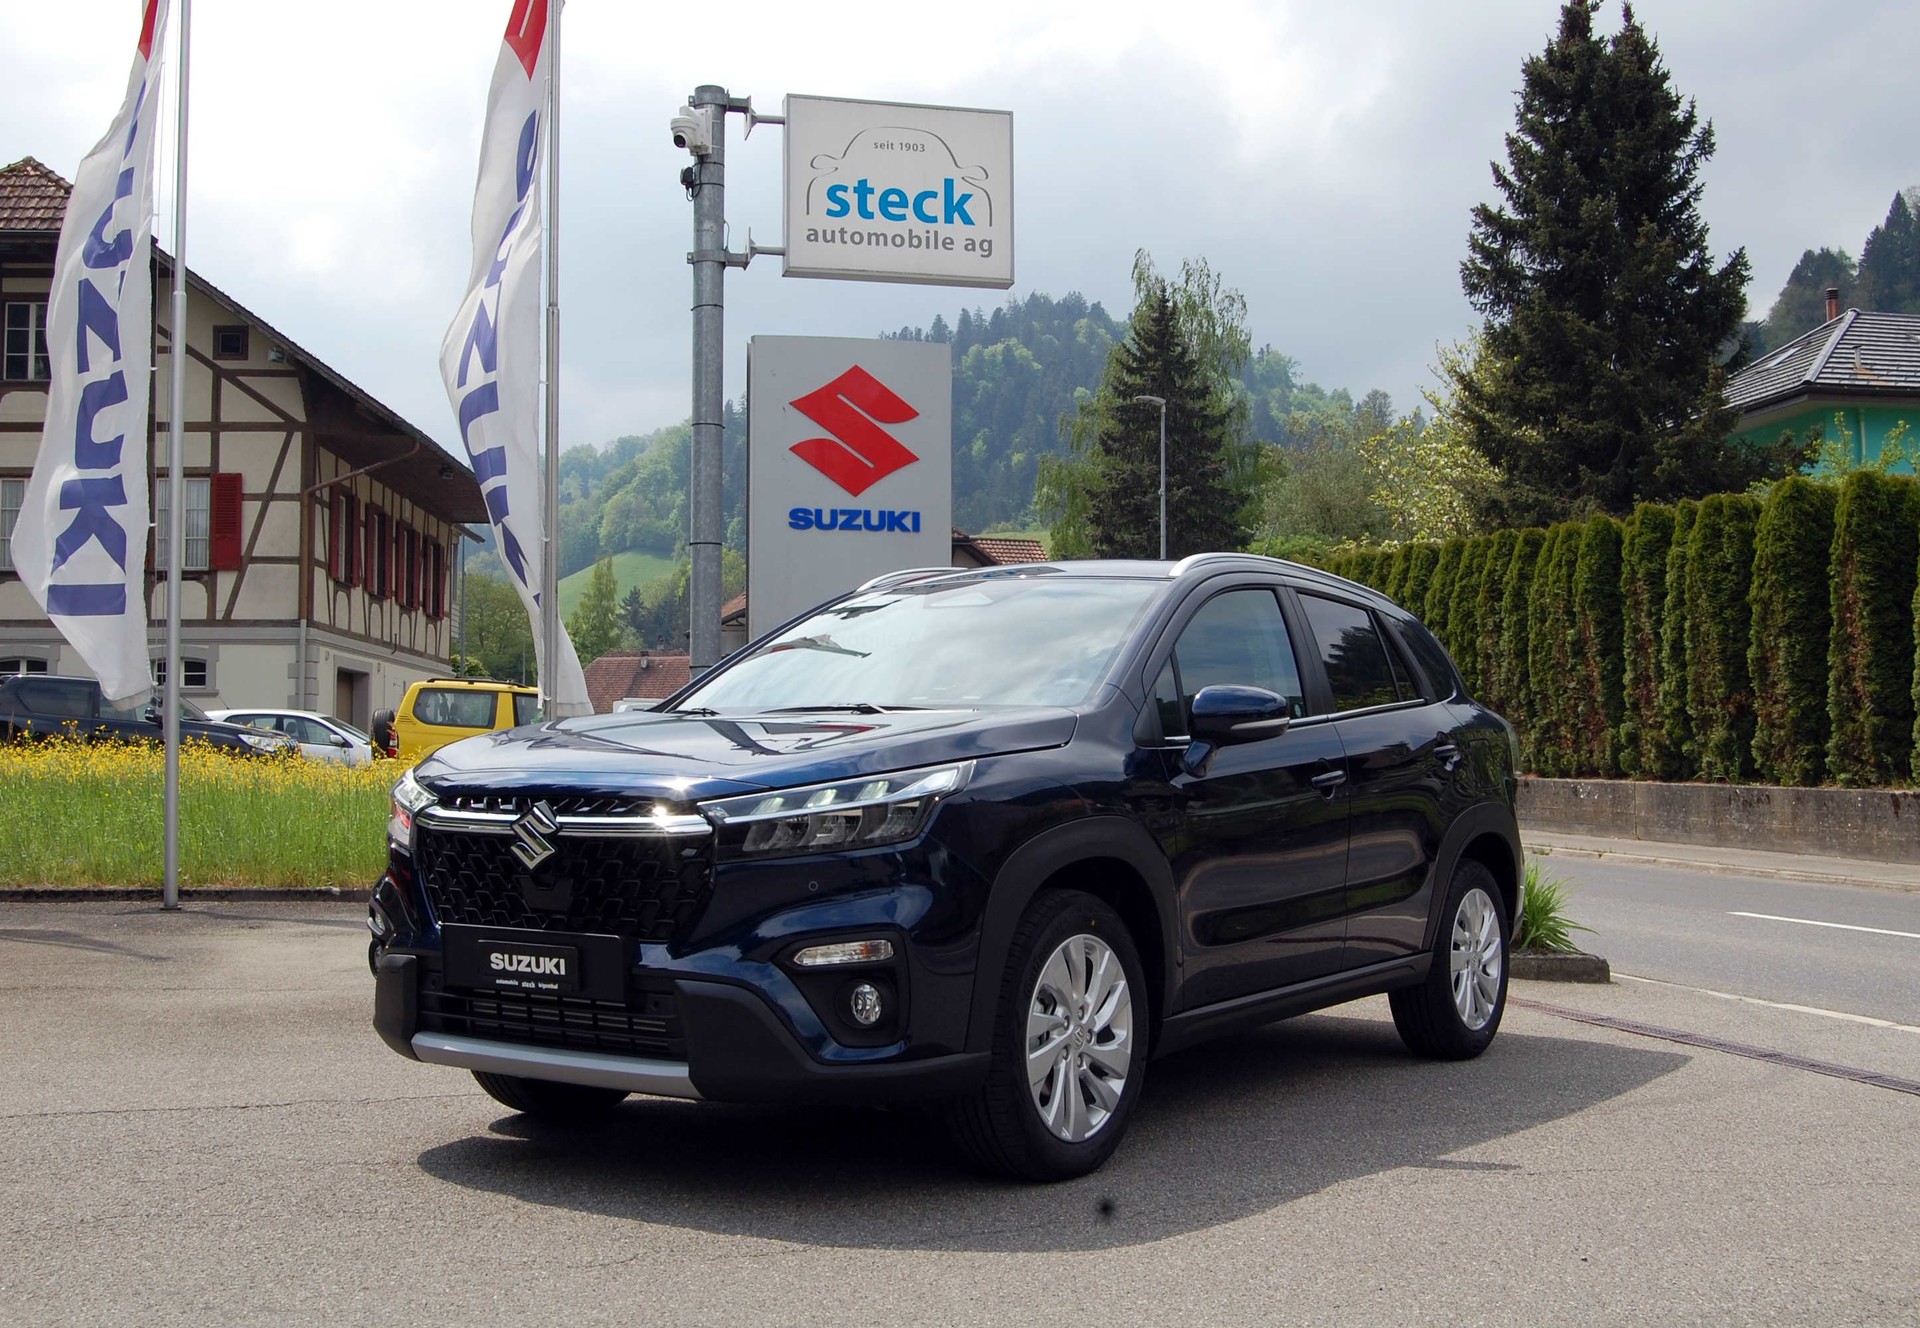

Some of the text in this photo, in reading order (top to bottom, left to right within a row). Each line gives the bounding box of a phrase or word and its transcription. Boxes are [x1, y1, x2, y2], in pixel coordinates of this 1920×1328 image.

[873, 140, 926, 153] seit 1903
[825, 178, 976, 226] steck
[806, 227, 993, 258] automobile ag
[788, 507, 920, 533] SUZUKI
[490, 953, 566, 975] SUZUKI
